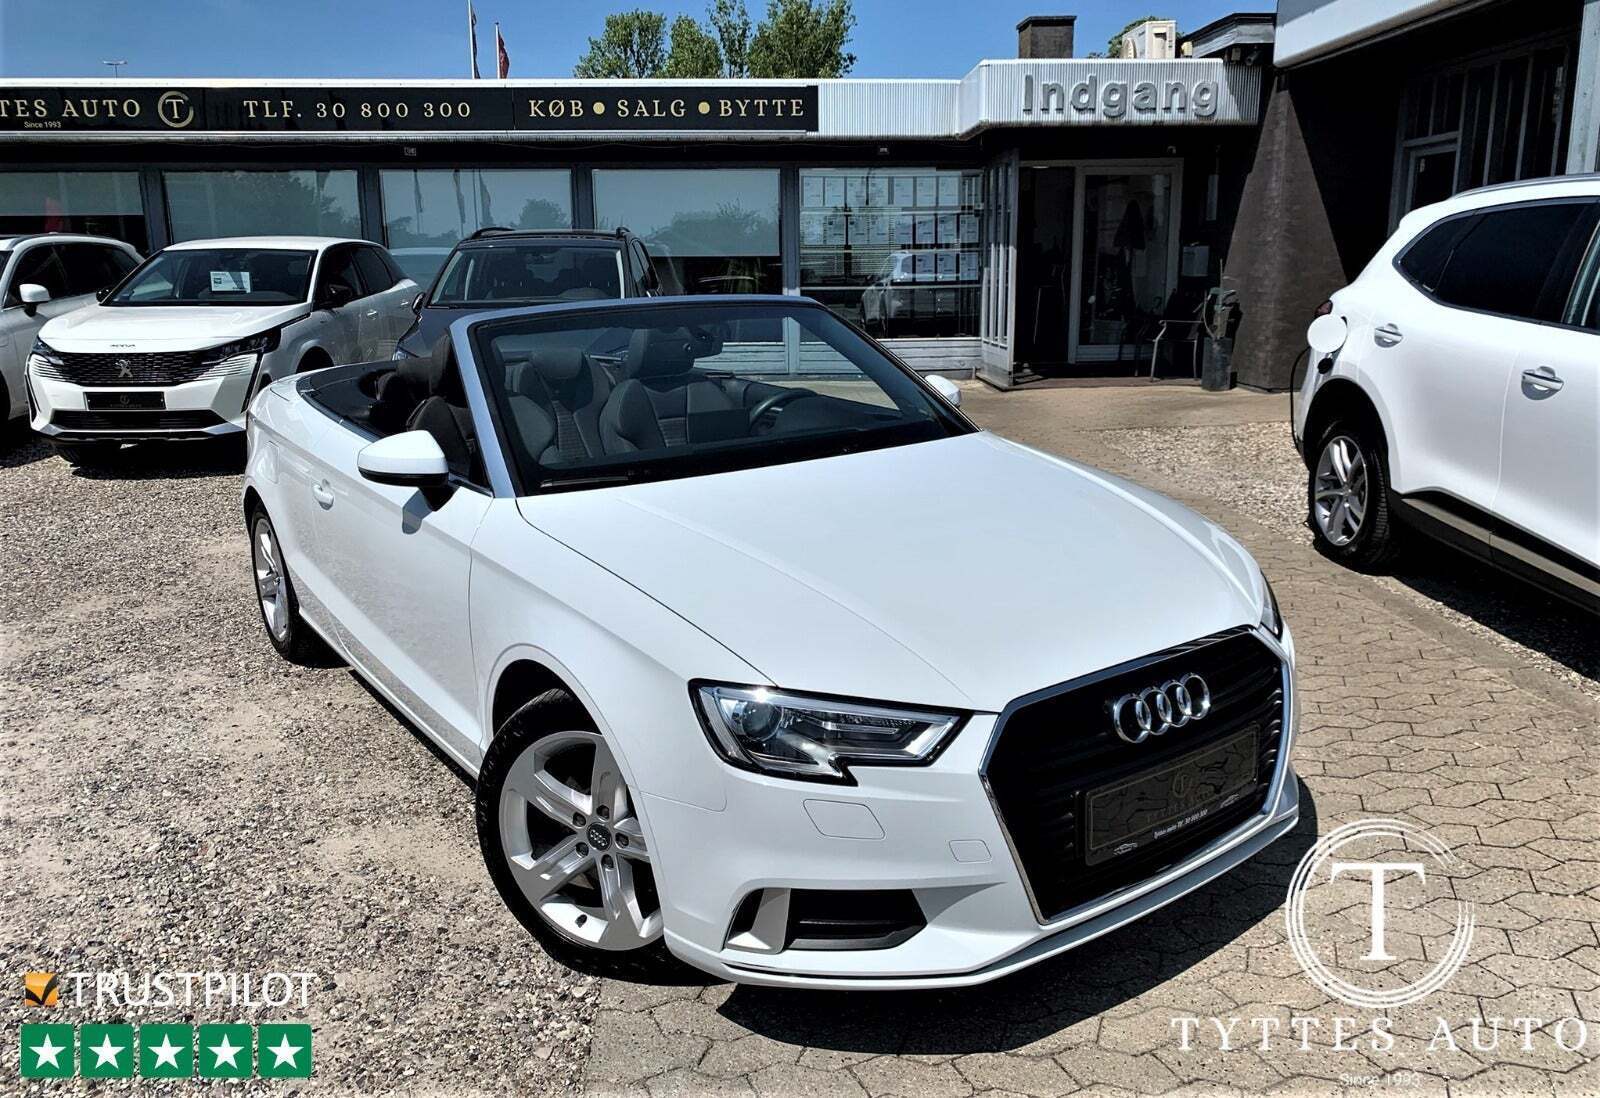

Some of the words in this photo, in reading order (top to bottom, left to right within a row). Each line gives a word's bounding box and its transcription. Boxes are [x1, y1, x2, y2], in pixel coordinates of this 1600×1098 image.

[1023, 74, 1219, 119] Indgang
[62, 98, 141, 119] AUTO
[243, 100, 302, 118] TLF.
[316, 101, 347, 118] 30
[360, 101, 409, 118] 800
[423, 101, 471, 118] 300
[528, 98, 585, 118] KØB
[617, 98, 688, 118] SALG
[719, 98, 805, 118] BYTTE
[24, 121, 43, 129] Since
[44, 121, 62, 129] 1993
